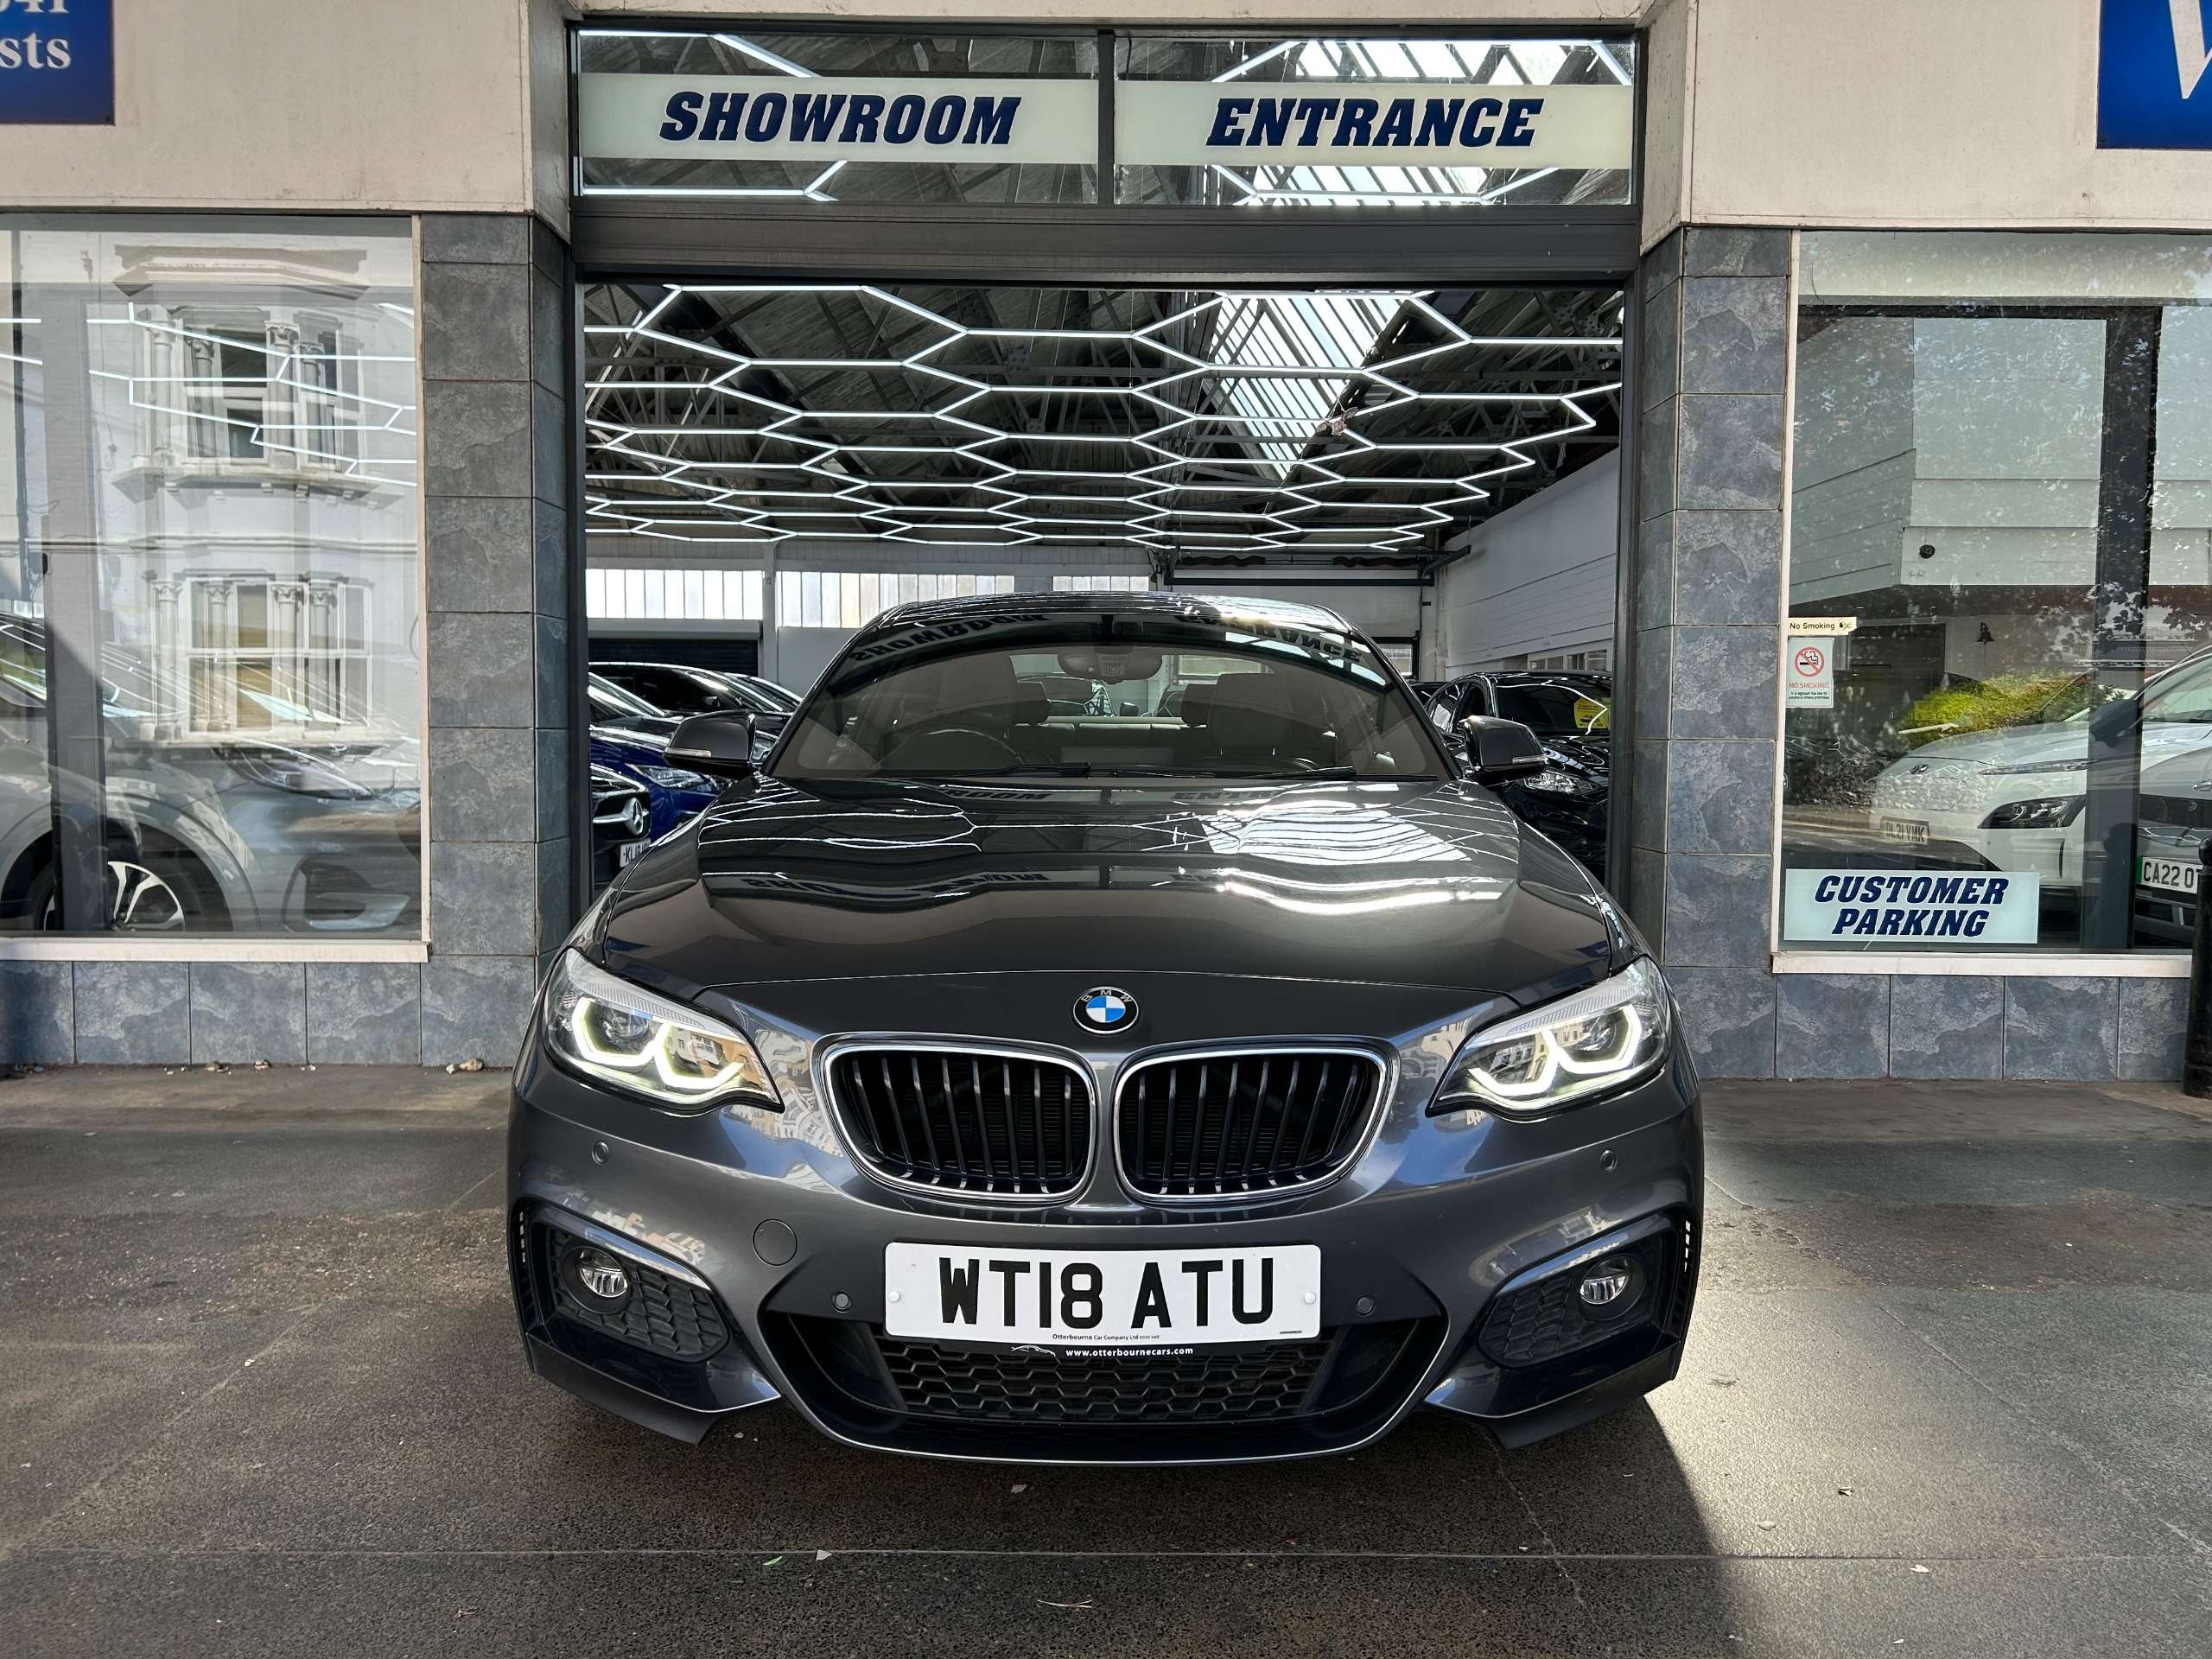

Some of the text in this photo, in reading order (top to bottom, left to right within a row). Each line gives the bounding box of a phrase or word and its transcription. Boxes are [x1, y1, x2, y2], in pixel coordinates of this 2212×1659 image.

[659, 91, 1021, 145] SHOWROOM
[1205, 97, 1544, 148] ENTRANCE
[1802, 622, 1835, 631] Smoking
[2143, 861, 2180, 887] CA22
[1815, 875, 2009, 905] CUSTOMER
[1831, 908, 1989, 938] PARKING
[1080, 989, 1133, 1002] BMW
[939, 1256, 1274, 1329] WT18 ATU
[1065, 1348, 1193, 1357] www.otterbournecars.com
